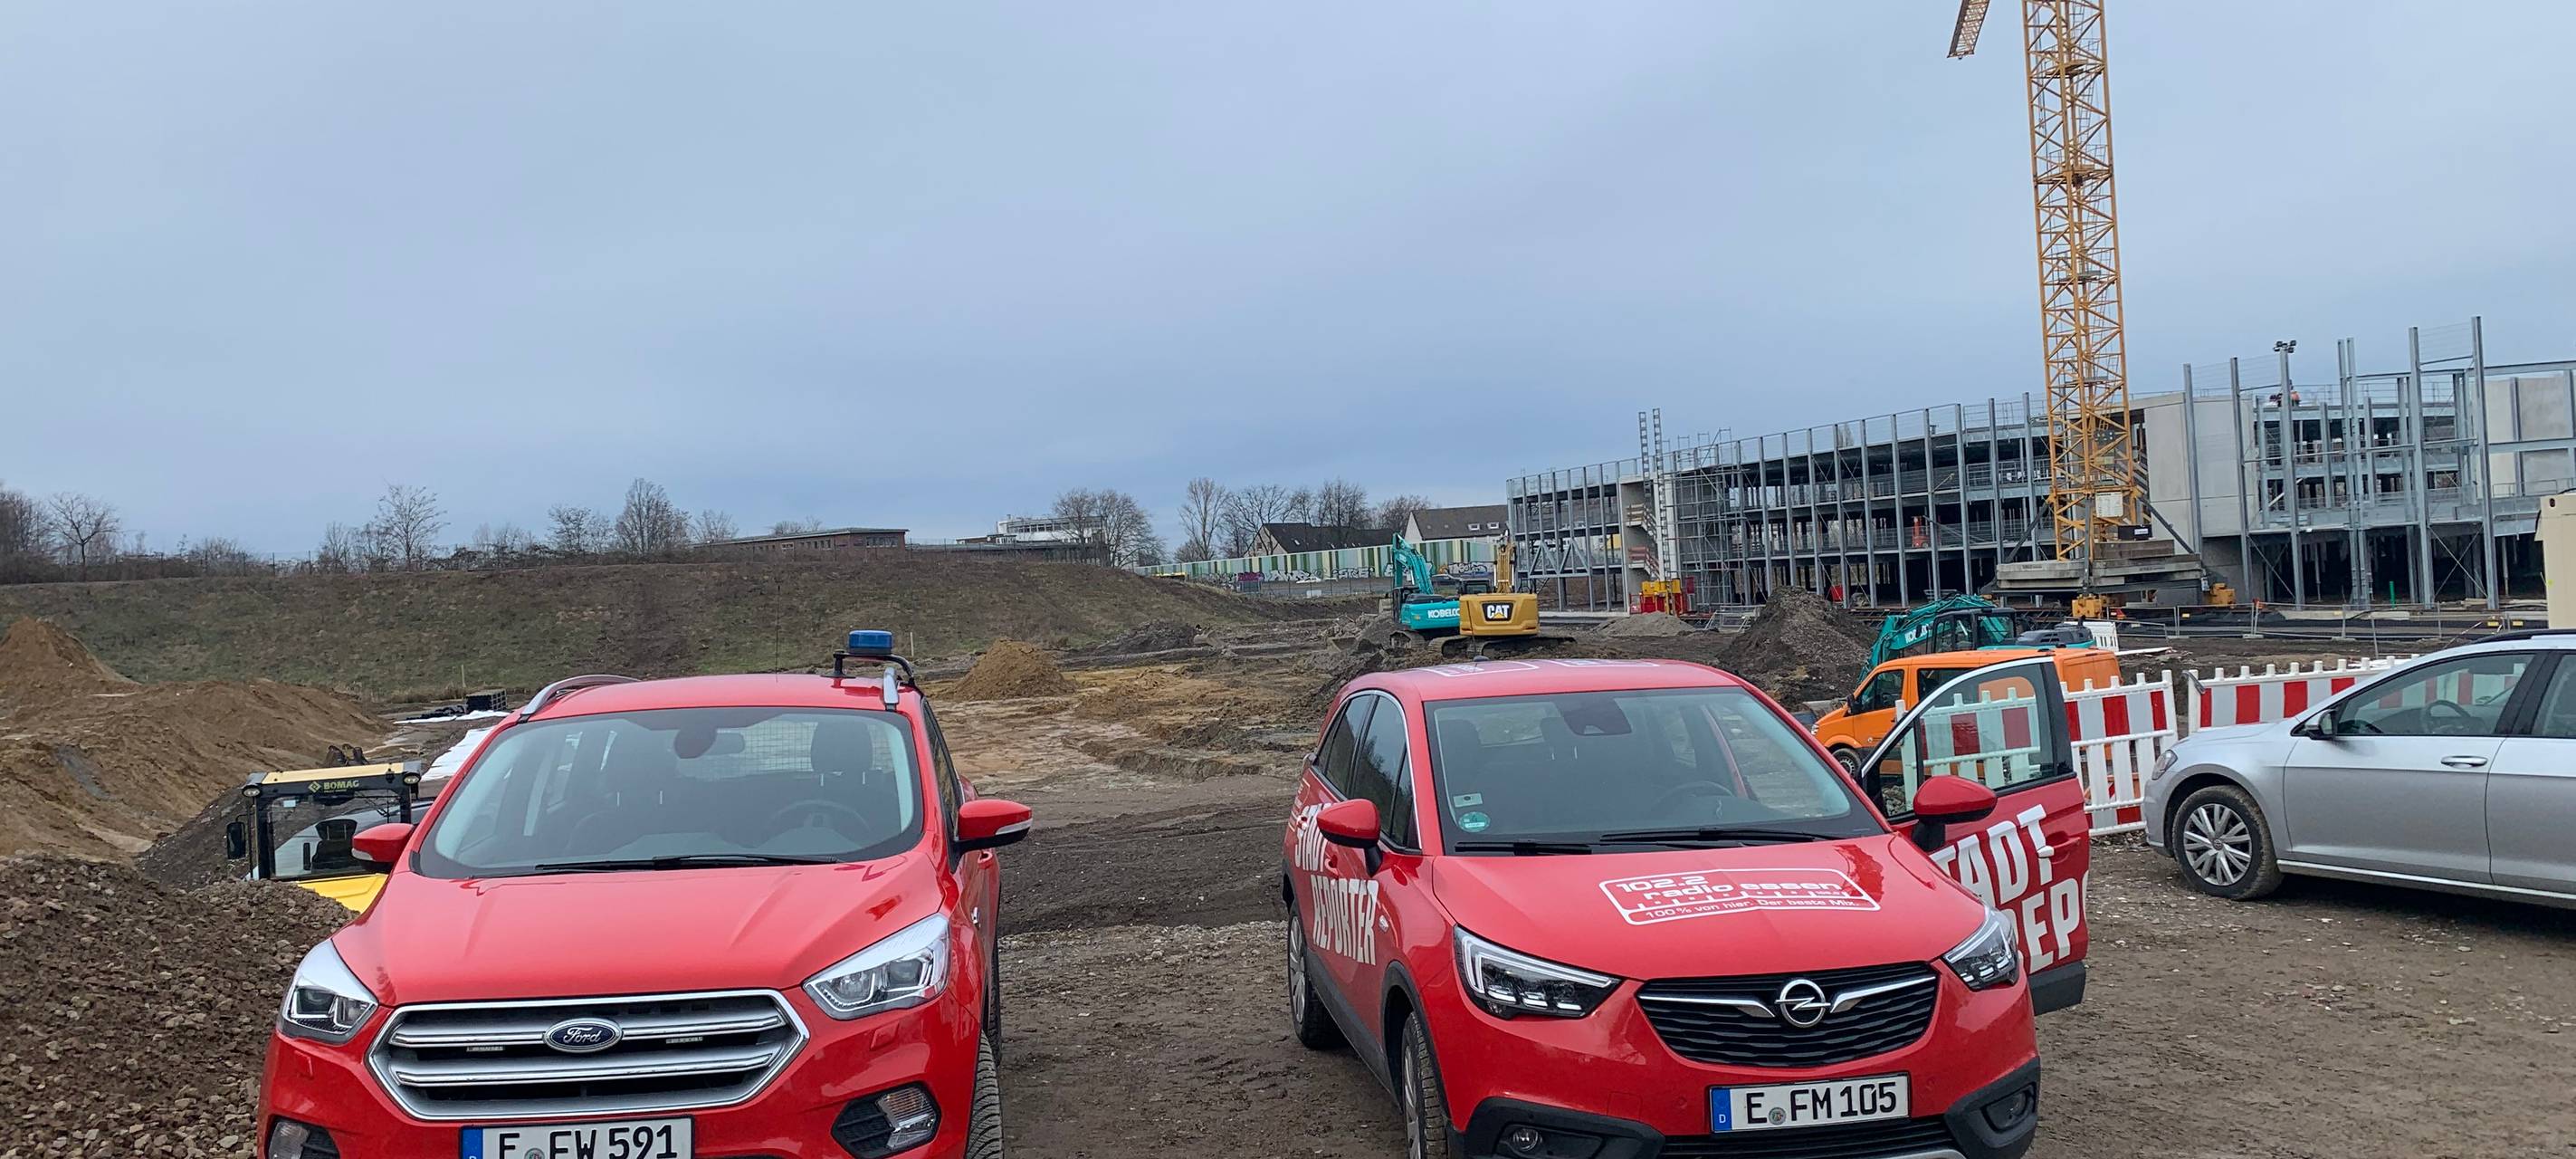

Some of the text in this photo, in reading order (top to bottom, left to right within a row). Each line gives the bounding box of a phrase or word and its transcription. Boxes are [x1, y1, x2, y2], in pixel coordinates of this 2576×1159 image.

[1487, 605, 1510, 619] CAT
[1616, 876, 1709, 893] 102.2
[1643, 882, 1843, 901] radio essen
[1722, 900, 1753, 909] hier.
[1757, 899, 1783, 907] Der
[1787, 899, 1827, 907] beste
[1311, 875, 1379, 966] REPORTER
[563, 1026, 601, 1044] Ford
[1746, 1081, 1896, 1125] E FM 105
[1719, 1114, 1726, 1124] D
[608, 1125, 678, 1159] 591
